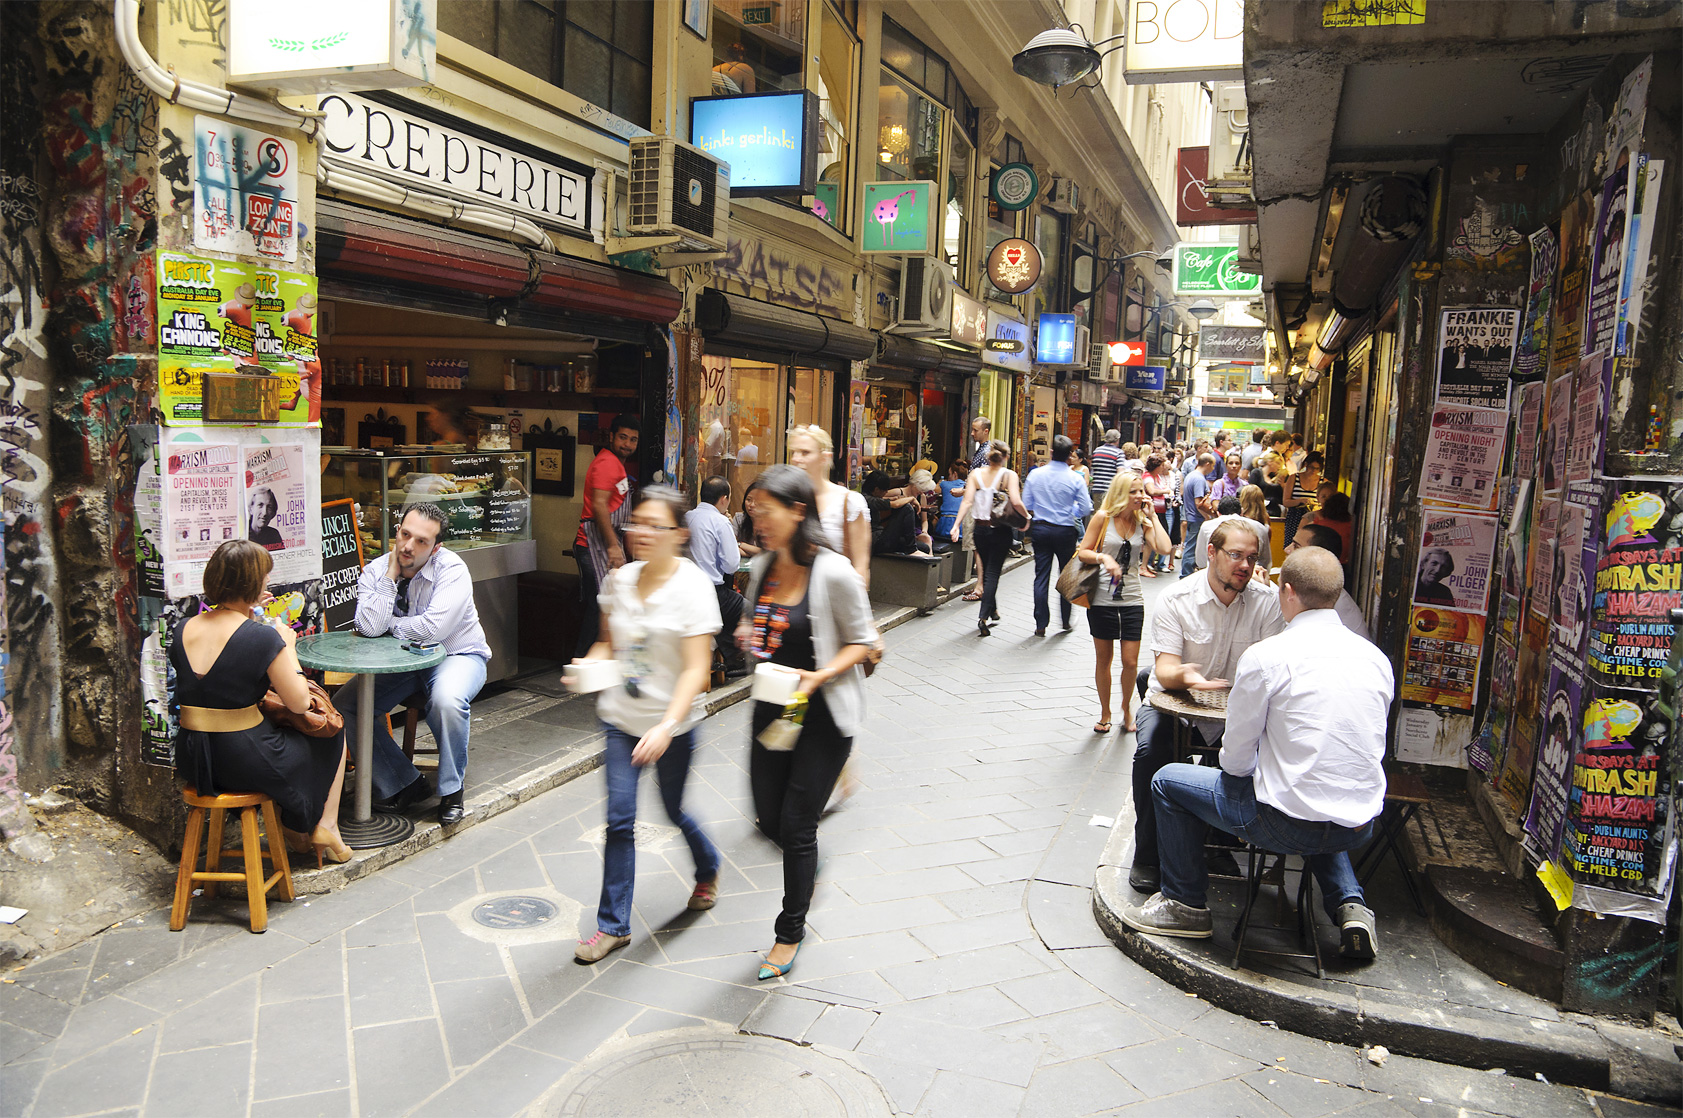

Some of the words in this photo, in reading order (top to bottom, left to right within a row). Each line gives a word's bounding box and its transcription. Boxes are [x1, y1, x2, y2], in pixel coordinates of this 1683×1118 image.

[207, 130, 216, 147] 7
[700, 129, 733, 151] kinki
[739, 126, 795, 150] gerlinki
[318, 94, 578, 221] CREPERIE
[251, 216, 290, 237] ZONE
[1183, 252, 1213, 273] Cafe
[164, 260, 212, 283] PLASTIC
[162, 286, 194, 296] AUSTRALIA
[162, 292, 187, 300] MONDAY
[195, 294, 219, 302] JANUARY
[174, 312, 206, 330] KING
[1447, 310, 1515, 326] FRANKIE
[162, 326, 220, 347] CANNONS
[1446, 325, 1486, 336] WANTS
[1490, 327, 1512, 337] OUT
[992, 341, 1015, 350] FOKUS
[1470, 397, 1490, 407] SOCIAL
[1491, 398, 1506, 409] CLUB
[1435, 411, 1474, 425] MARXISM
[1474, 411, 1499, 427] 2010
[1434, 430, 1471, 443] OPENING
[1471, 435, 1497, 447] NIGHT
[170, 449, 208, 470] MARXISM
[208, 445, 231, 465] 2010
[1471, 446, 1488, 454] CRISIS
[246, 448, 273, 471] MARXISM
[1457, 456, 1487, 465] CENTURY
[173, 477, 208, 489] OPENING
[210, 476, 234, 488] NIGHT
[180, 504, 195, 512] 21ST
[200, 503, 227, 511] CENTURY
[286, 499, 306, 513] JOHN
[276, 511, 306, 527] PILGER
[322, 513, 350, 538] UNCH
[1427, 518, 1456, 532] MARXISM
[1450, 525, 1472, 540] 2010
[298, 548, 316, 559] HOTEL
[321, 534, 357, 560] PECIALS
[1660, 546, 1683, 564] AT
[145, 560, 159, 569] NEW
[1463, 565, 1488, 579] JOHN
[322, 571, 340, 590] EEF
[339, 564, 361, 584] CREPE
[1449, 575, 1486, 591] PILGER
[1606, 591, 1682, 617] SHAZAM
[1619, 623, 1647, 635] DUBLIN
[1648, 624, 1675, 636] AUNTS
[1617, 635, 1653, 646] BACKYARD
[1613, 645, 1641, 657] CHEAP
[1642, 648, 1671, 660] DRINKS
[1405, 717, 1430, 725] Wednesday
[1405, 723, 1424, 731] January
[1636, 755, 1661, 769] AT
[1580, 790, 1656, 822] SHAZAM
[1594, 824, 1622, 837] DUBLIN
[1623, 827, 1649, 840] AUNTS
[1591, 834, 1627, 848] BACKYARD
[1587, 844, 1614, 858] CHEAP
[1615, 847, 1644, 863] DRINKS
[1619, 868, 1643, 881] CBD
